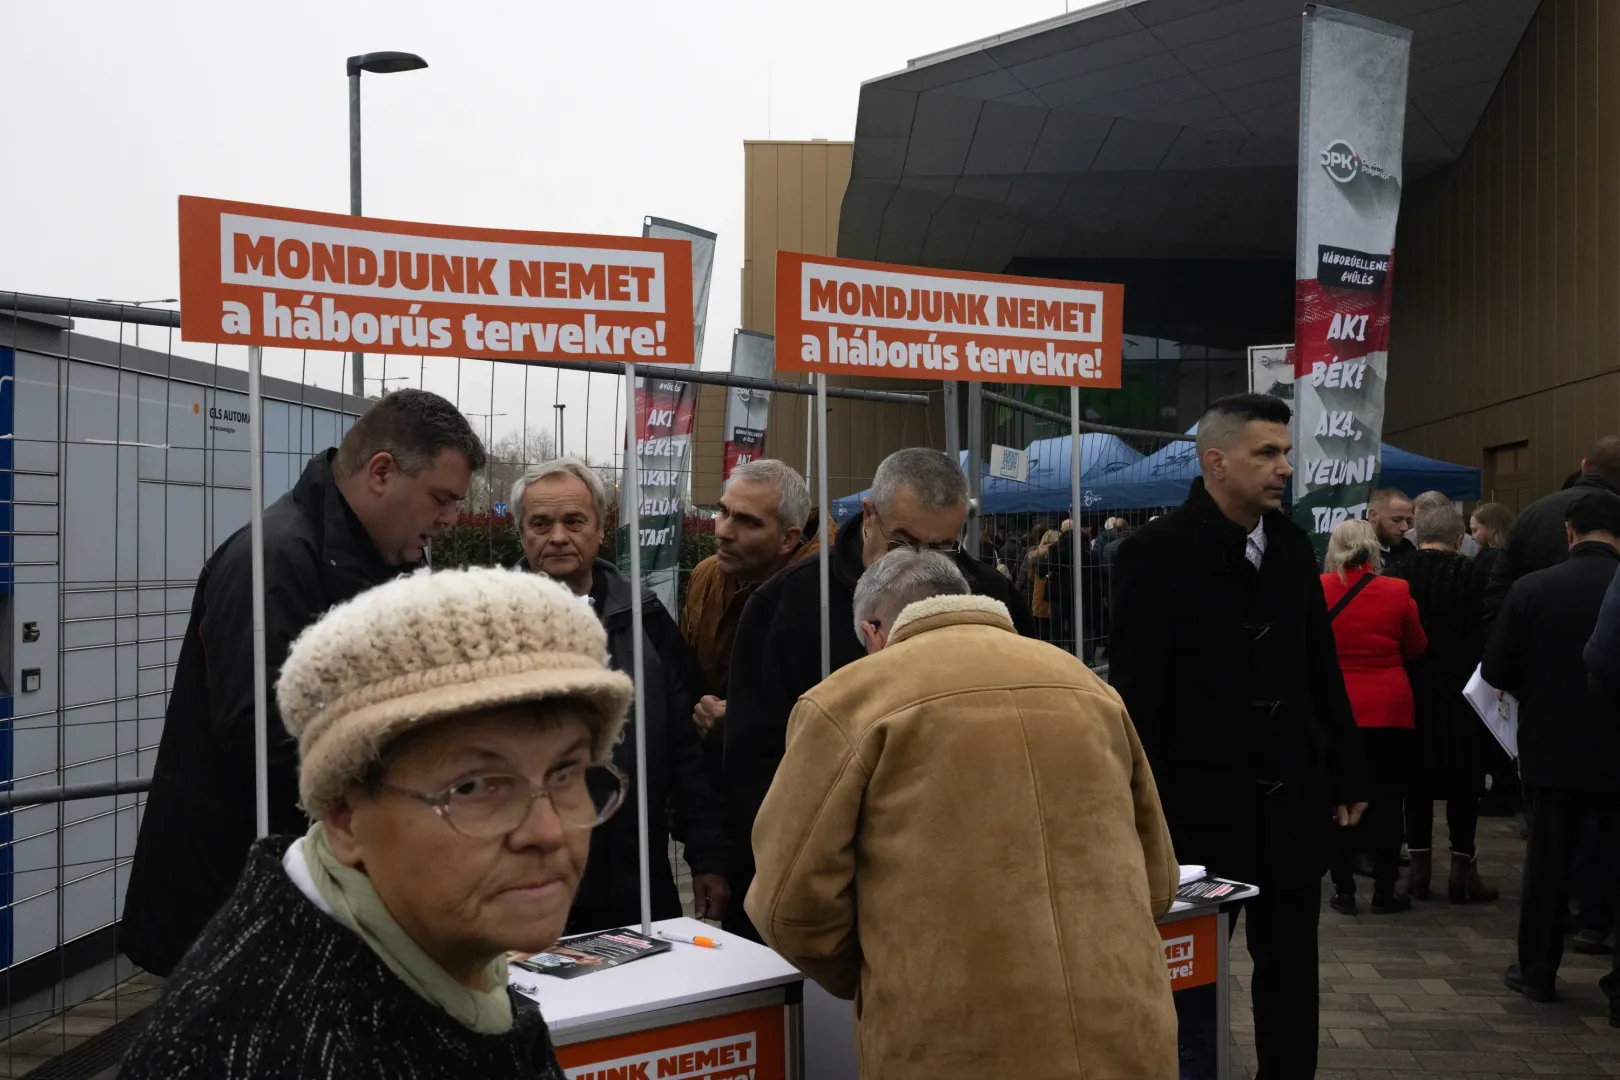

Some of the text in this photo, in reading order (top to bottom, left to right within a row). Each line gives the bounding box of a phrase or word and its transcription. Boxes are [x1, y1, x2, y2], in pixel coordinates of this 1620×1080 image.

[233, 232, 655, 303] MONDJUNK NEMET
[1322, 251, 1388, 272] HÁBORÚELLENE
[809, 278, 1096, 333] MONDJUNK NEMET
[221, 292, 667, 357] a háborús tervekre!
[1326, 312, 1369, 341] AKI
[801, 326, 1102, 379] a háborús tervekre!
[1312, 356, 1367, 389] BÉKE
[210, 408, 223, 420] GLS
[648, 409, 675, 427] AKI
[637, 436, 687, 457] BÉKET
[657, 1040, 753, 1079] NEMET
